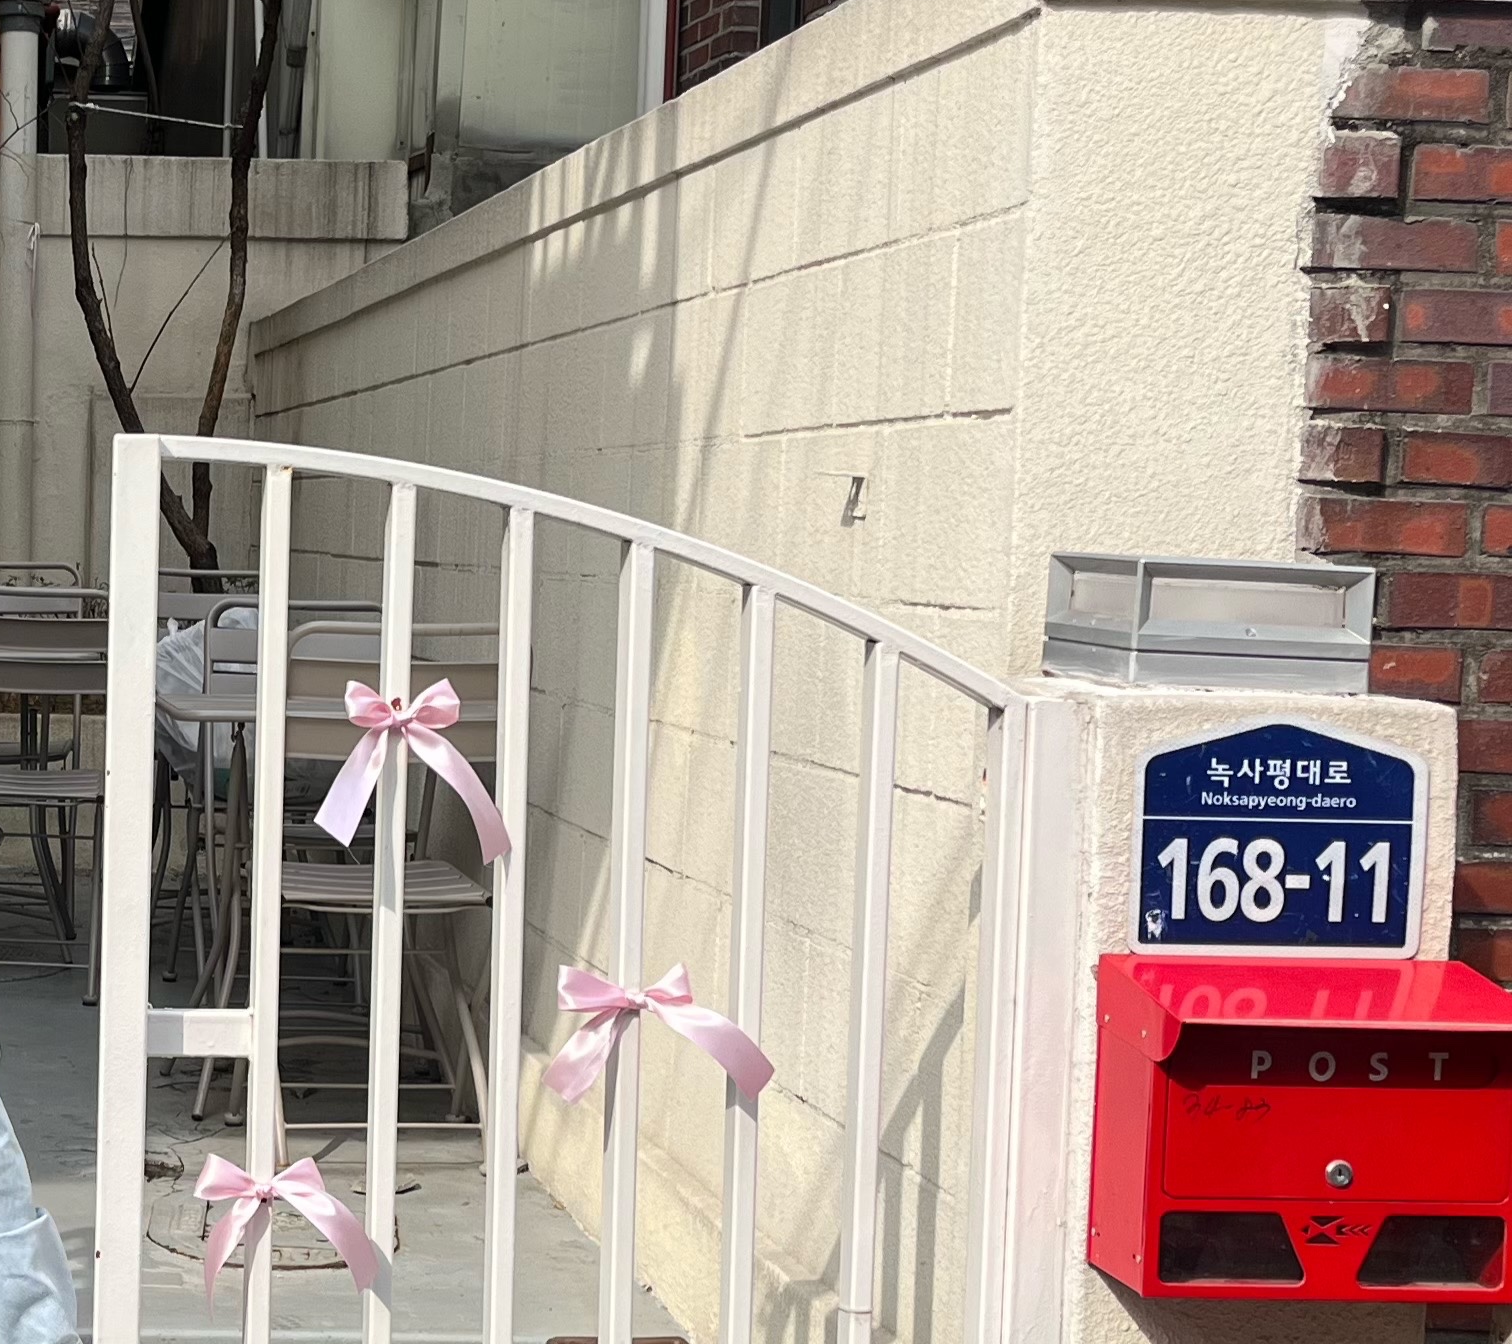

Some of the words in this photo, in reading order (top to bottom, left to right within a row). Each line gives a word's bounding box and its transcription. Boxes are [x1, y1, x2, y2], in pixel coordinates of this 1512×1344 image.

[1206, 757, 1352, 790] 녹사평대로
[1201, 791, 1357, 811] Noksapyeong-daero
[1157, 837, 1391, 923] 168-11
[1250, 1050, 1449, 1082] POST
